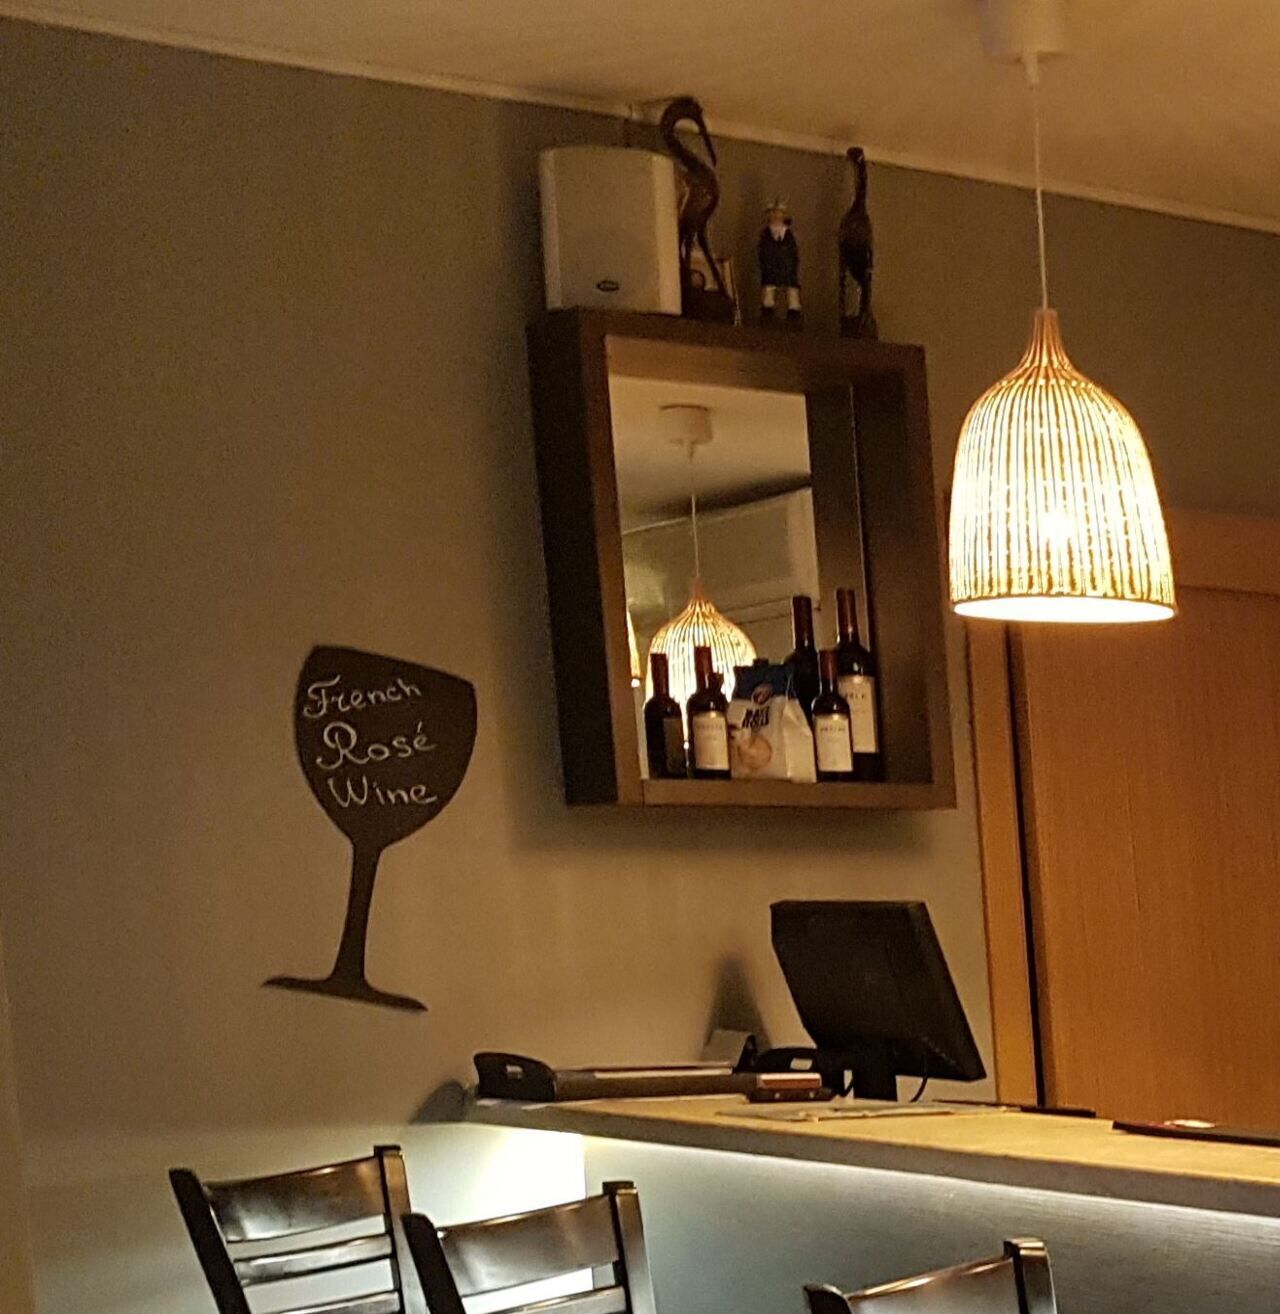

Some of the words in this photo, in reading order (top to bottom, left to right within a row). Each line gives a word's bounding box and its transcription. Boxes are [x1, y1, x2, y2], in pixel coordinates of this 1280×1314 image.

[303, 674, 422, 718] French
[315, 721, 438, 770] Rosé
[327, 776, 438, 808] Wine
